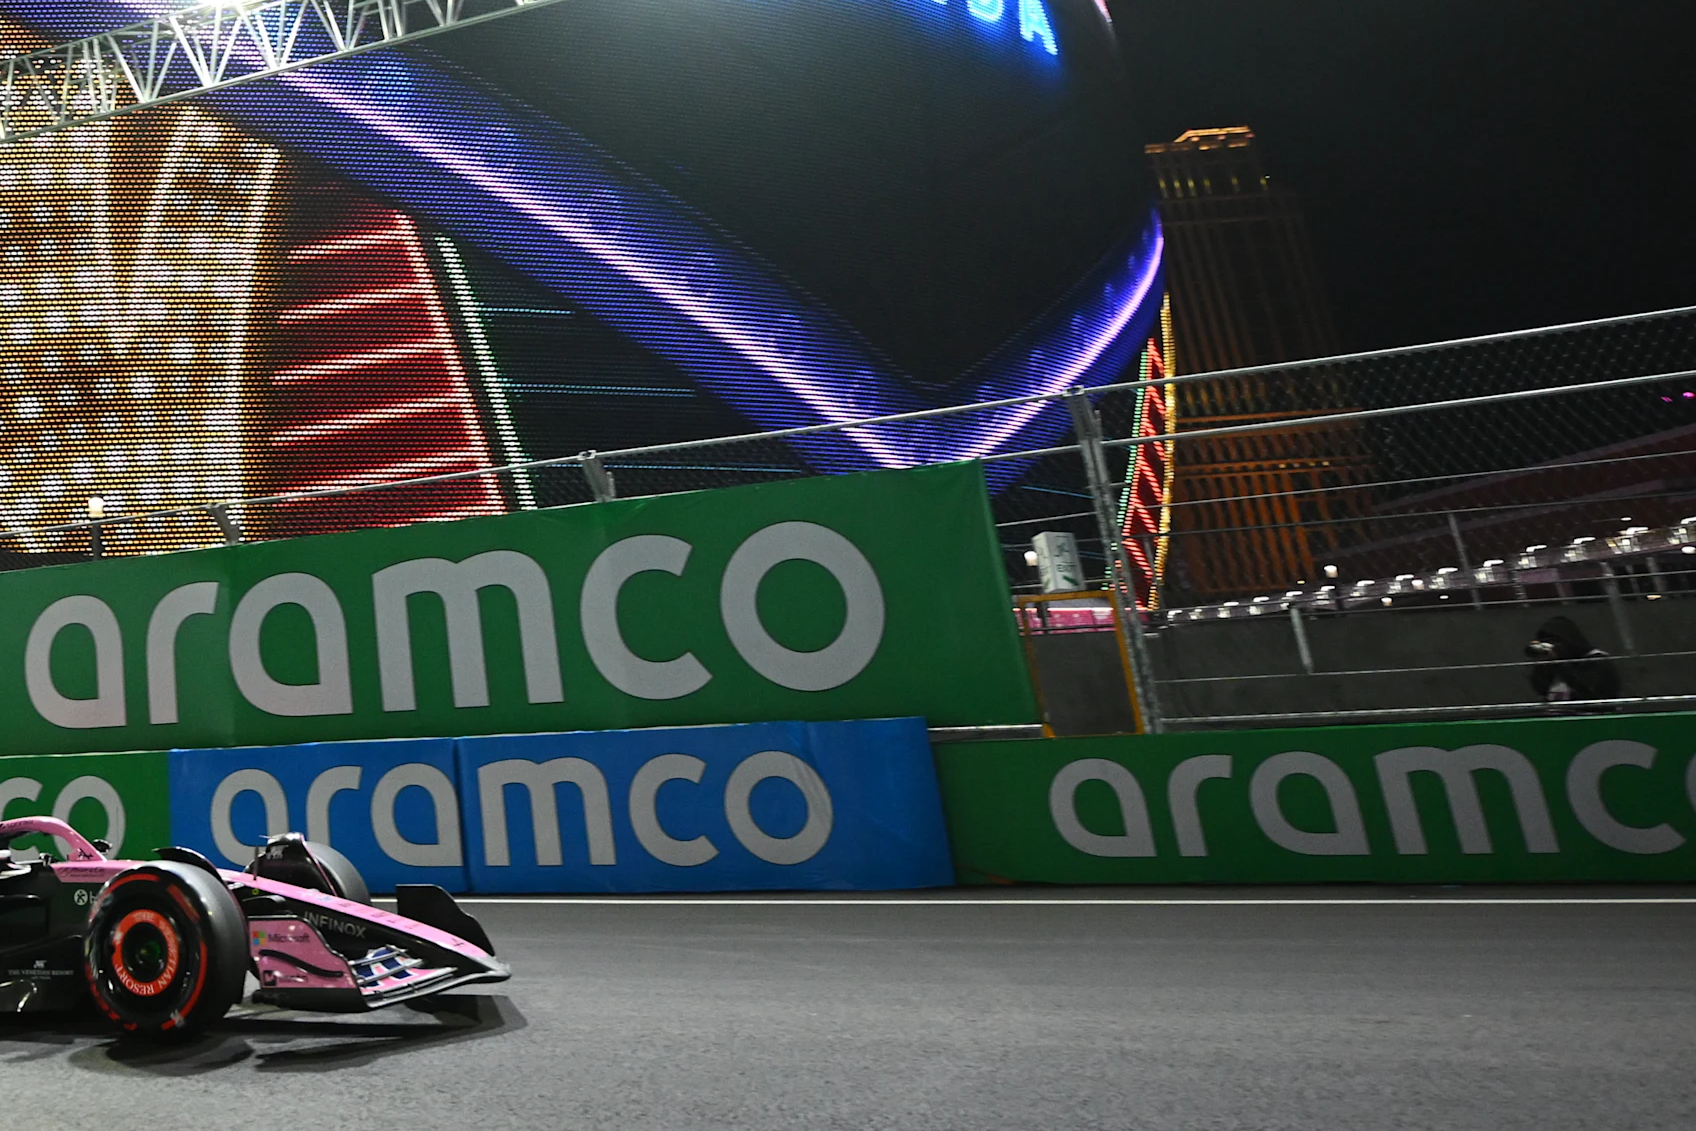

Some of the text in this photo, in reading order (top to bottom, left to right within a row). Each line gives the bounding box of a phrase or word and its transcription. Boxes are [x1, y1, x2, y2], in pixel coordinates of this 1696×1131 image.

[24, 521, 885, 729] aramco
[210, 750, 834, 868] aramco
[1049, 739, 1696, 858] aramc
[114, 964, 156, 995] RESORT
[304, 910, 367, 939] INFINOX
